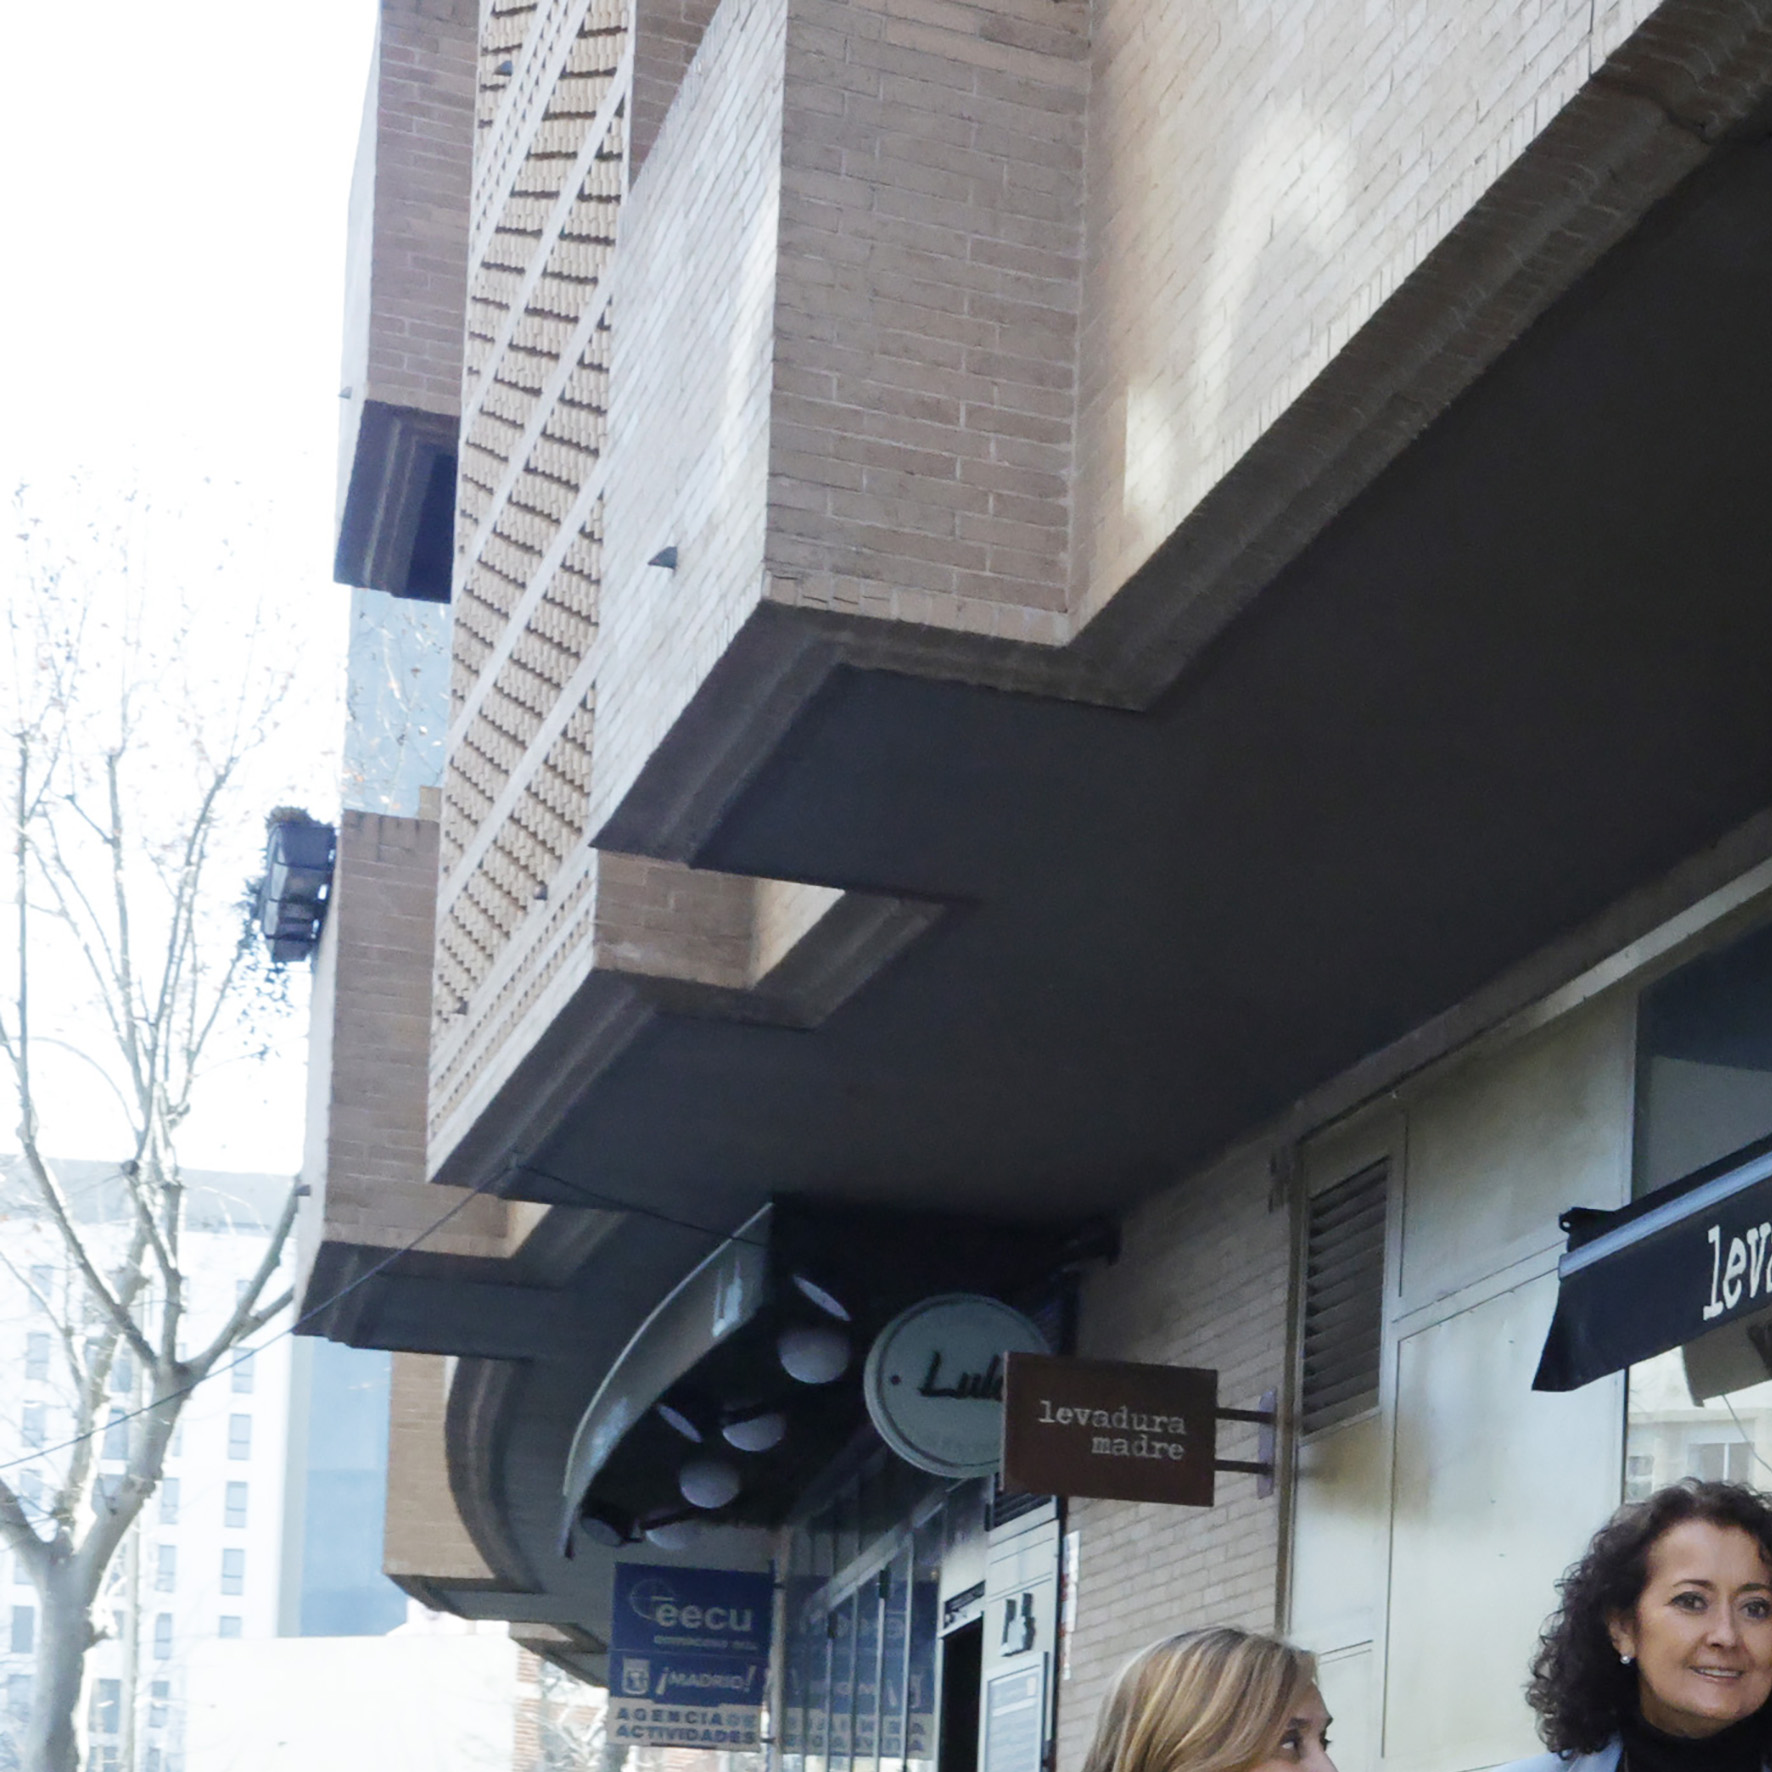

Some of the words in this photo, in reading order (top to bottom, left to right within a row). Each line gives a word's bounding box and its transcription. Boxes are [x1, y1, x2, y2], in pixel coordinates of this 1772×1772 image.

[1038, 1400, 1187, 1436] levadura
[1090, 1435, 1185, 1461] madre
[616, 1706, 722, 1725] AGENCIA
[615, 1723, 757, 1744] ACTIVIDADES
